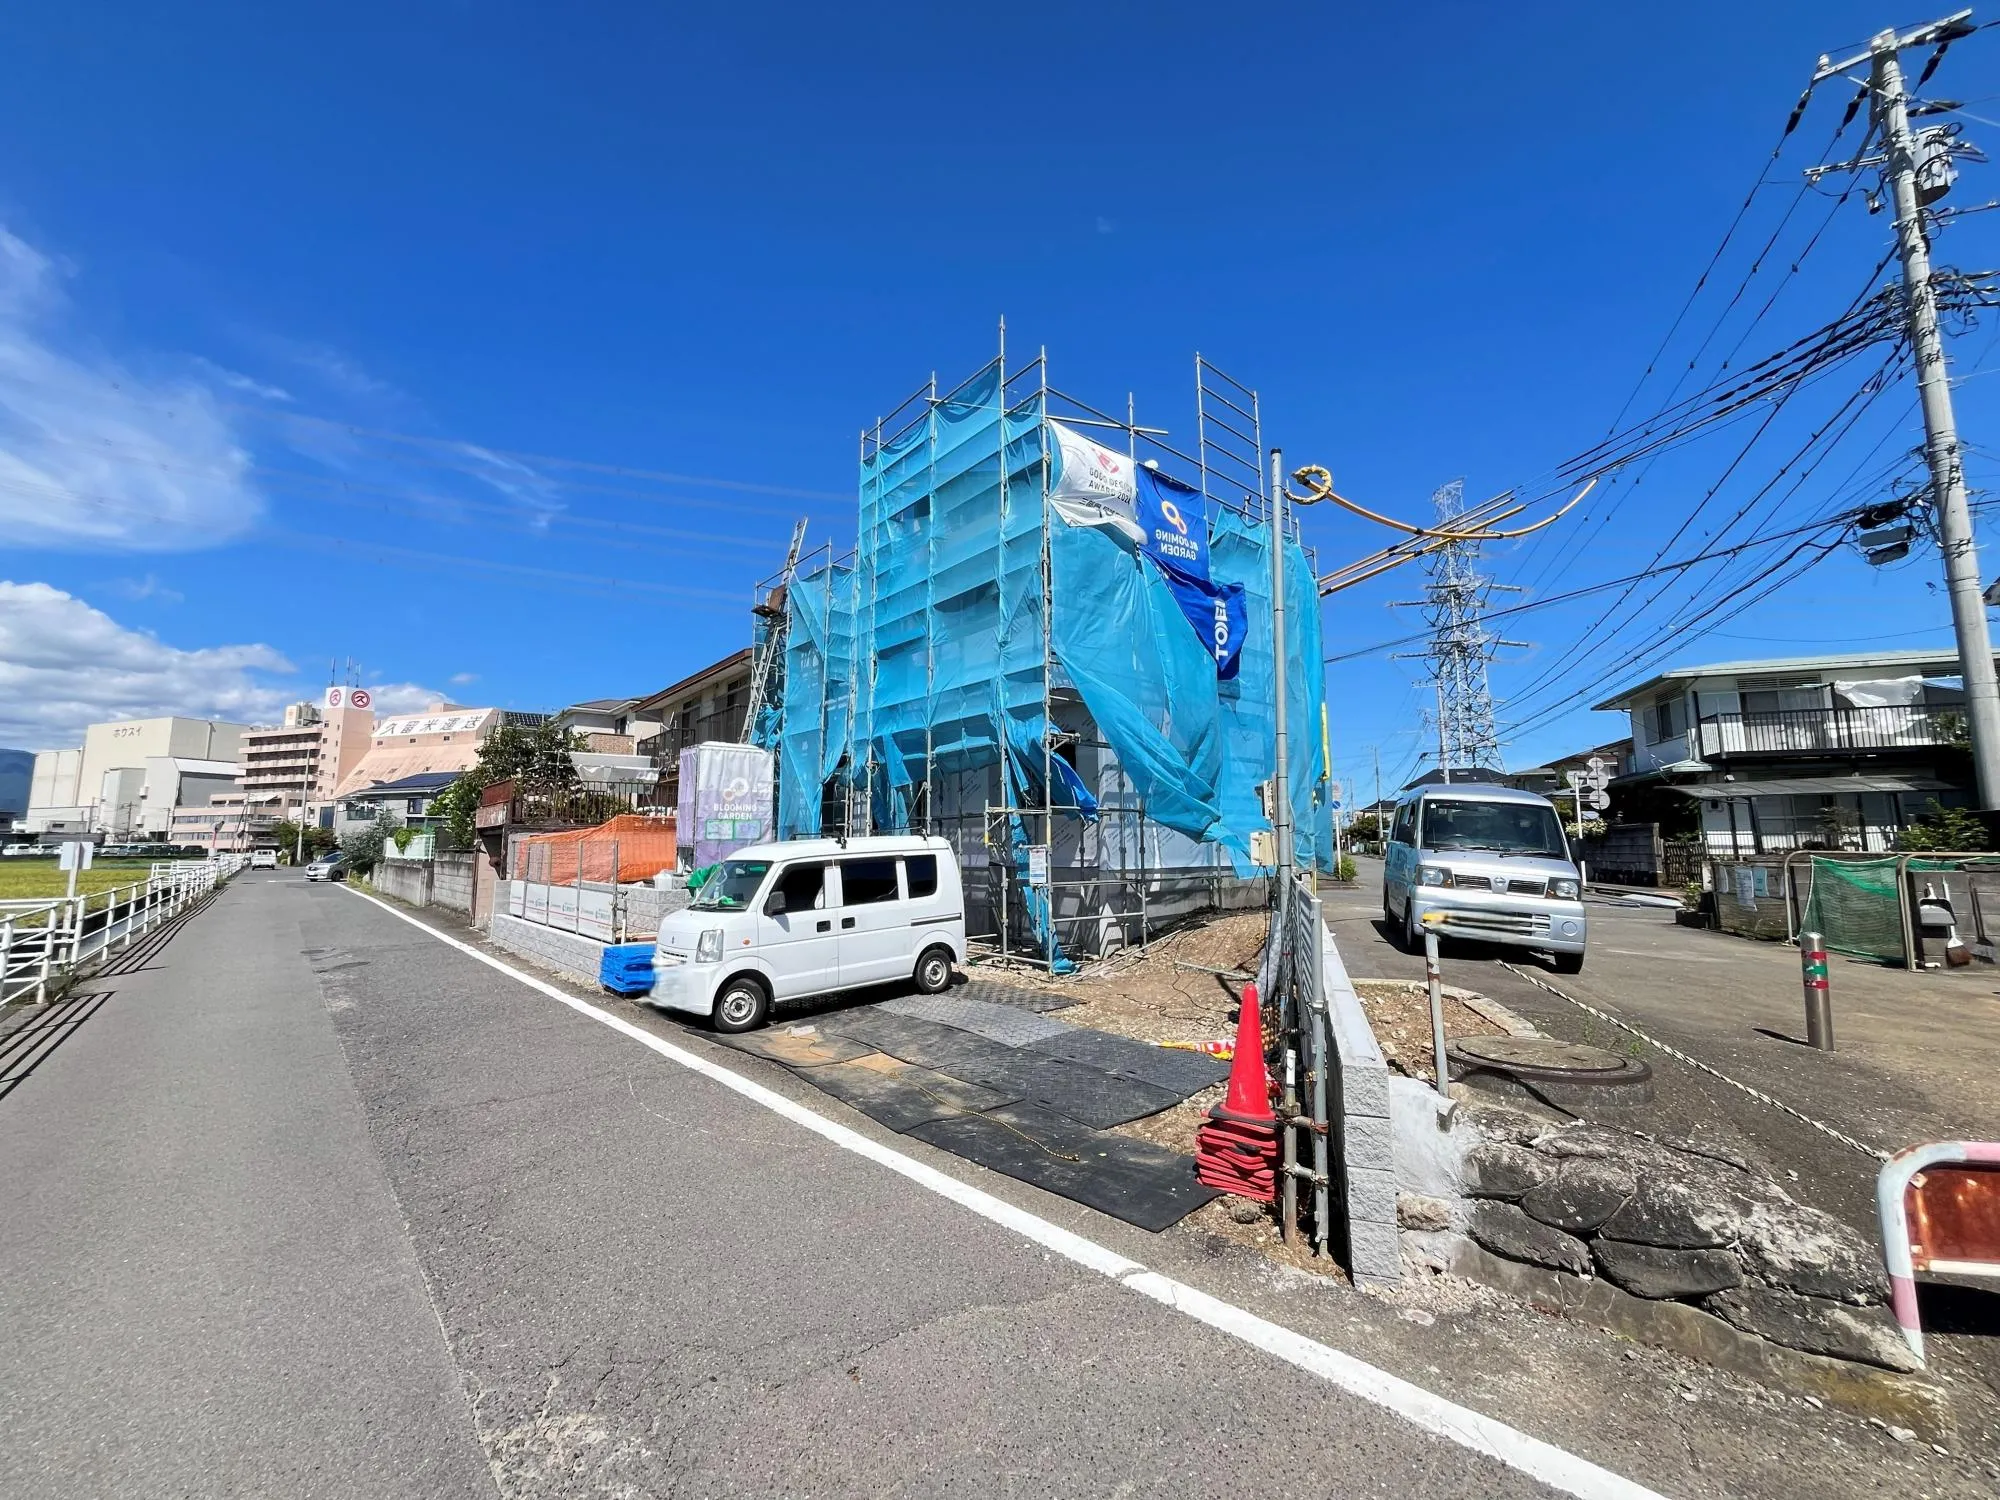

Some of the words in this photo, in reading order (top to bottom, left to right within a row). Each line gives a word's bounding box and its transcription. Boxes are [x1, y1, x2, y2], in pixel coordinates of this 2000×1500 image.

[1088, 479, 1116, 497] AWARD
[380, 714, 483, 735] 久留米運送
[713, 803, 758, 812] BLOOMING
[718, 812, 753, 821] GARDEN
